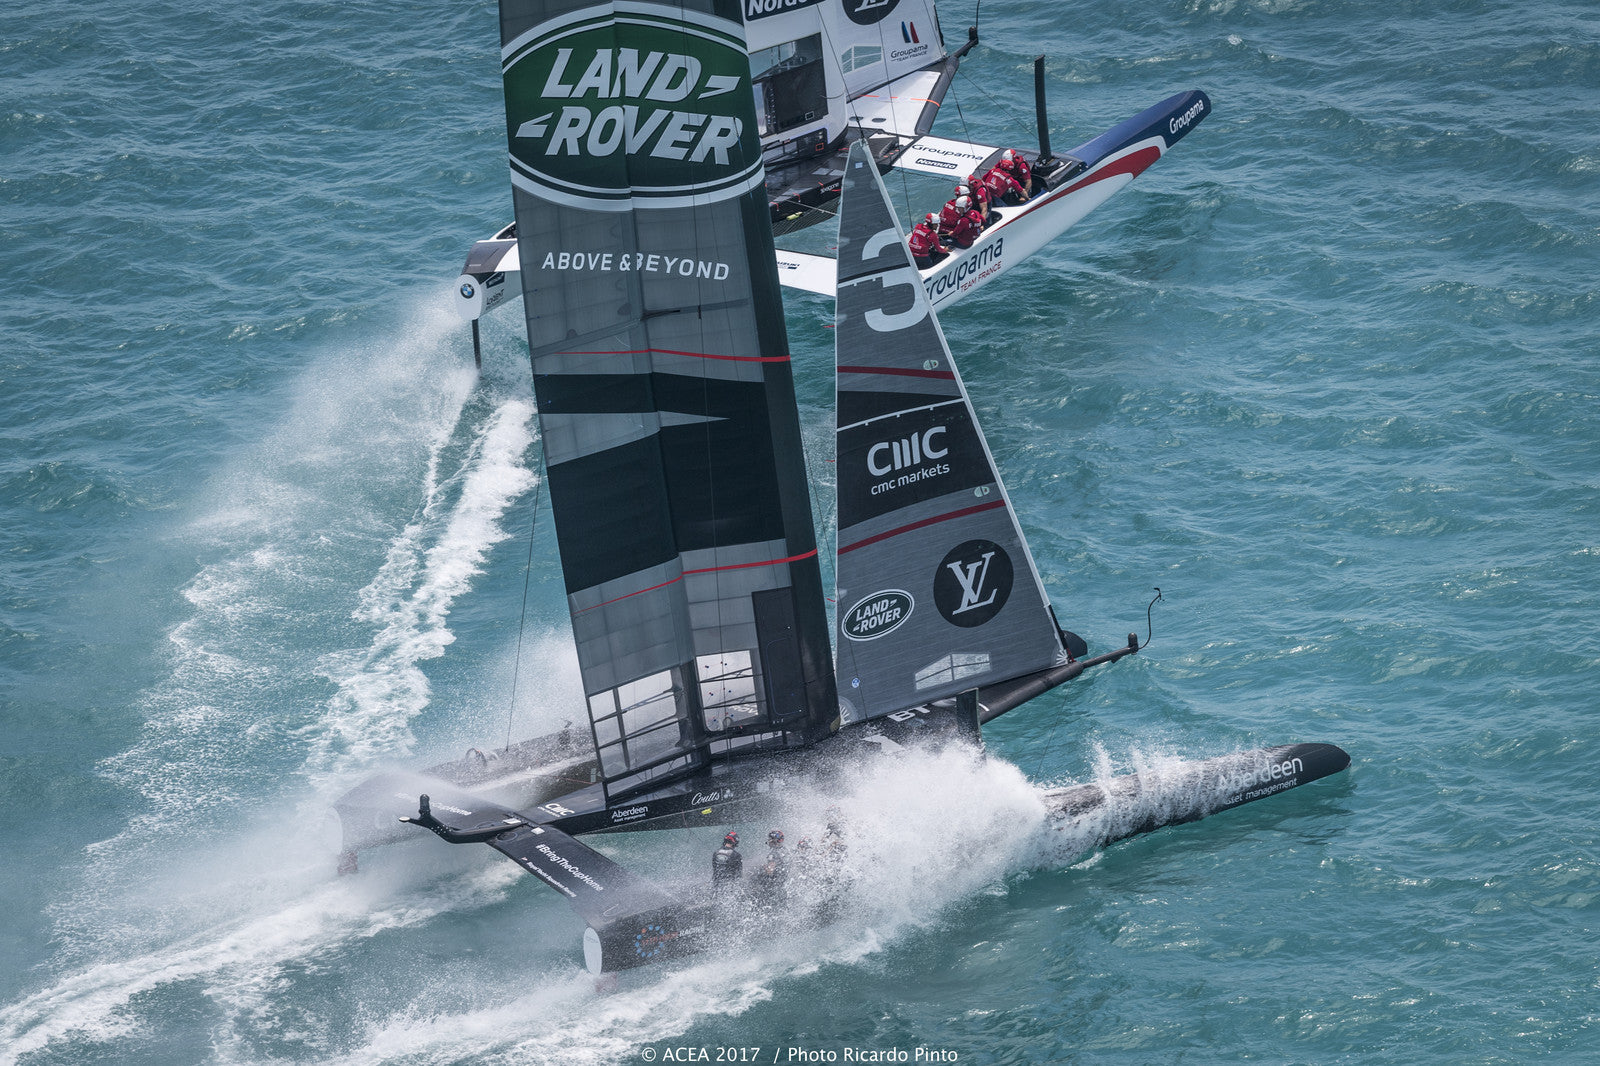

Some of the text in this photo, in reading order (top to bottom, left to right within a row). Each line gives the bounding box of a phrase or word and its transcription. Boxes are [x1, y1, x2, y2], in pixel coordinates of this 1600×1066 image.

[890, 44, 928, 58] Groupama
[541, 47, 702, 102] LAND
[1169, 99, 1204, 134] Groupama
[545, 105, 743, 166] ROVER
[912, 144, 984, 161] Groupama
[541, 252, 730, 281] ABOVE & BEYOND
[862, 227, 930, 332] 3
[960, 260, 1002, 292] TEAM FRANCE
[871, 463, 950, 496] cmc markets
[856, 599, 889, 622] LAND
[860, 607, 901, 633] ROVER
[691, 791, 720, 806] Coutts
[1245, 777, 1298, 800] management
[611, 805, 649, 820] Aberdeen
[535, 844, 604, 892] #BringTheCupHome
